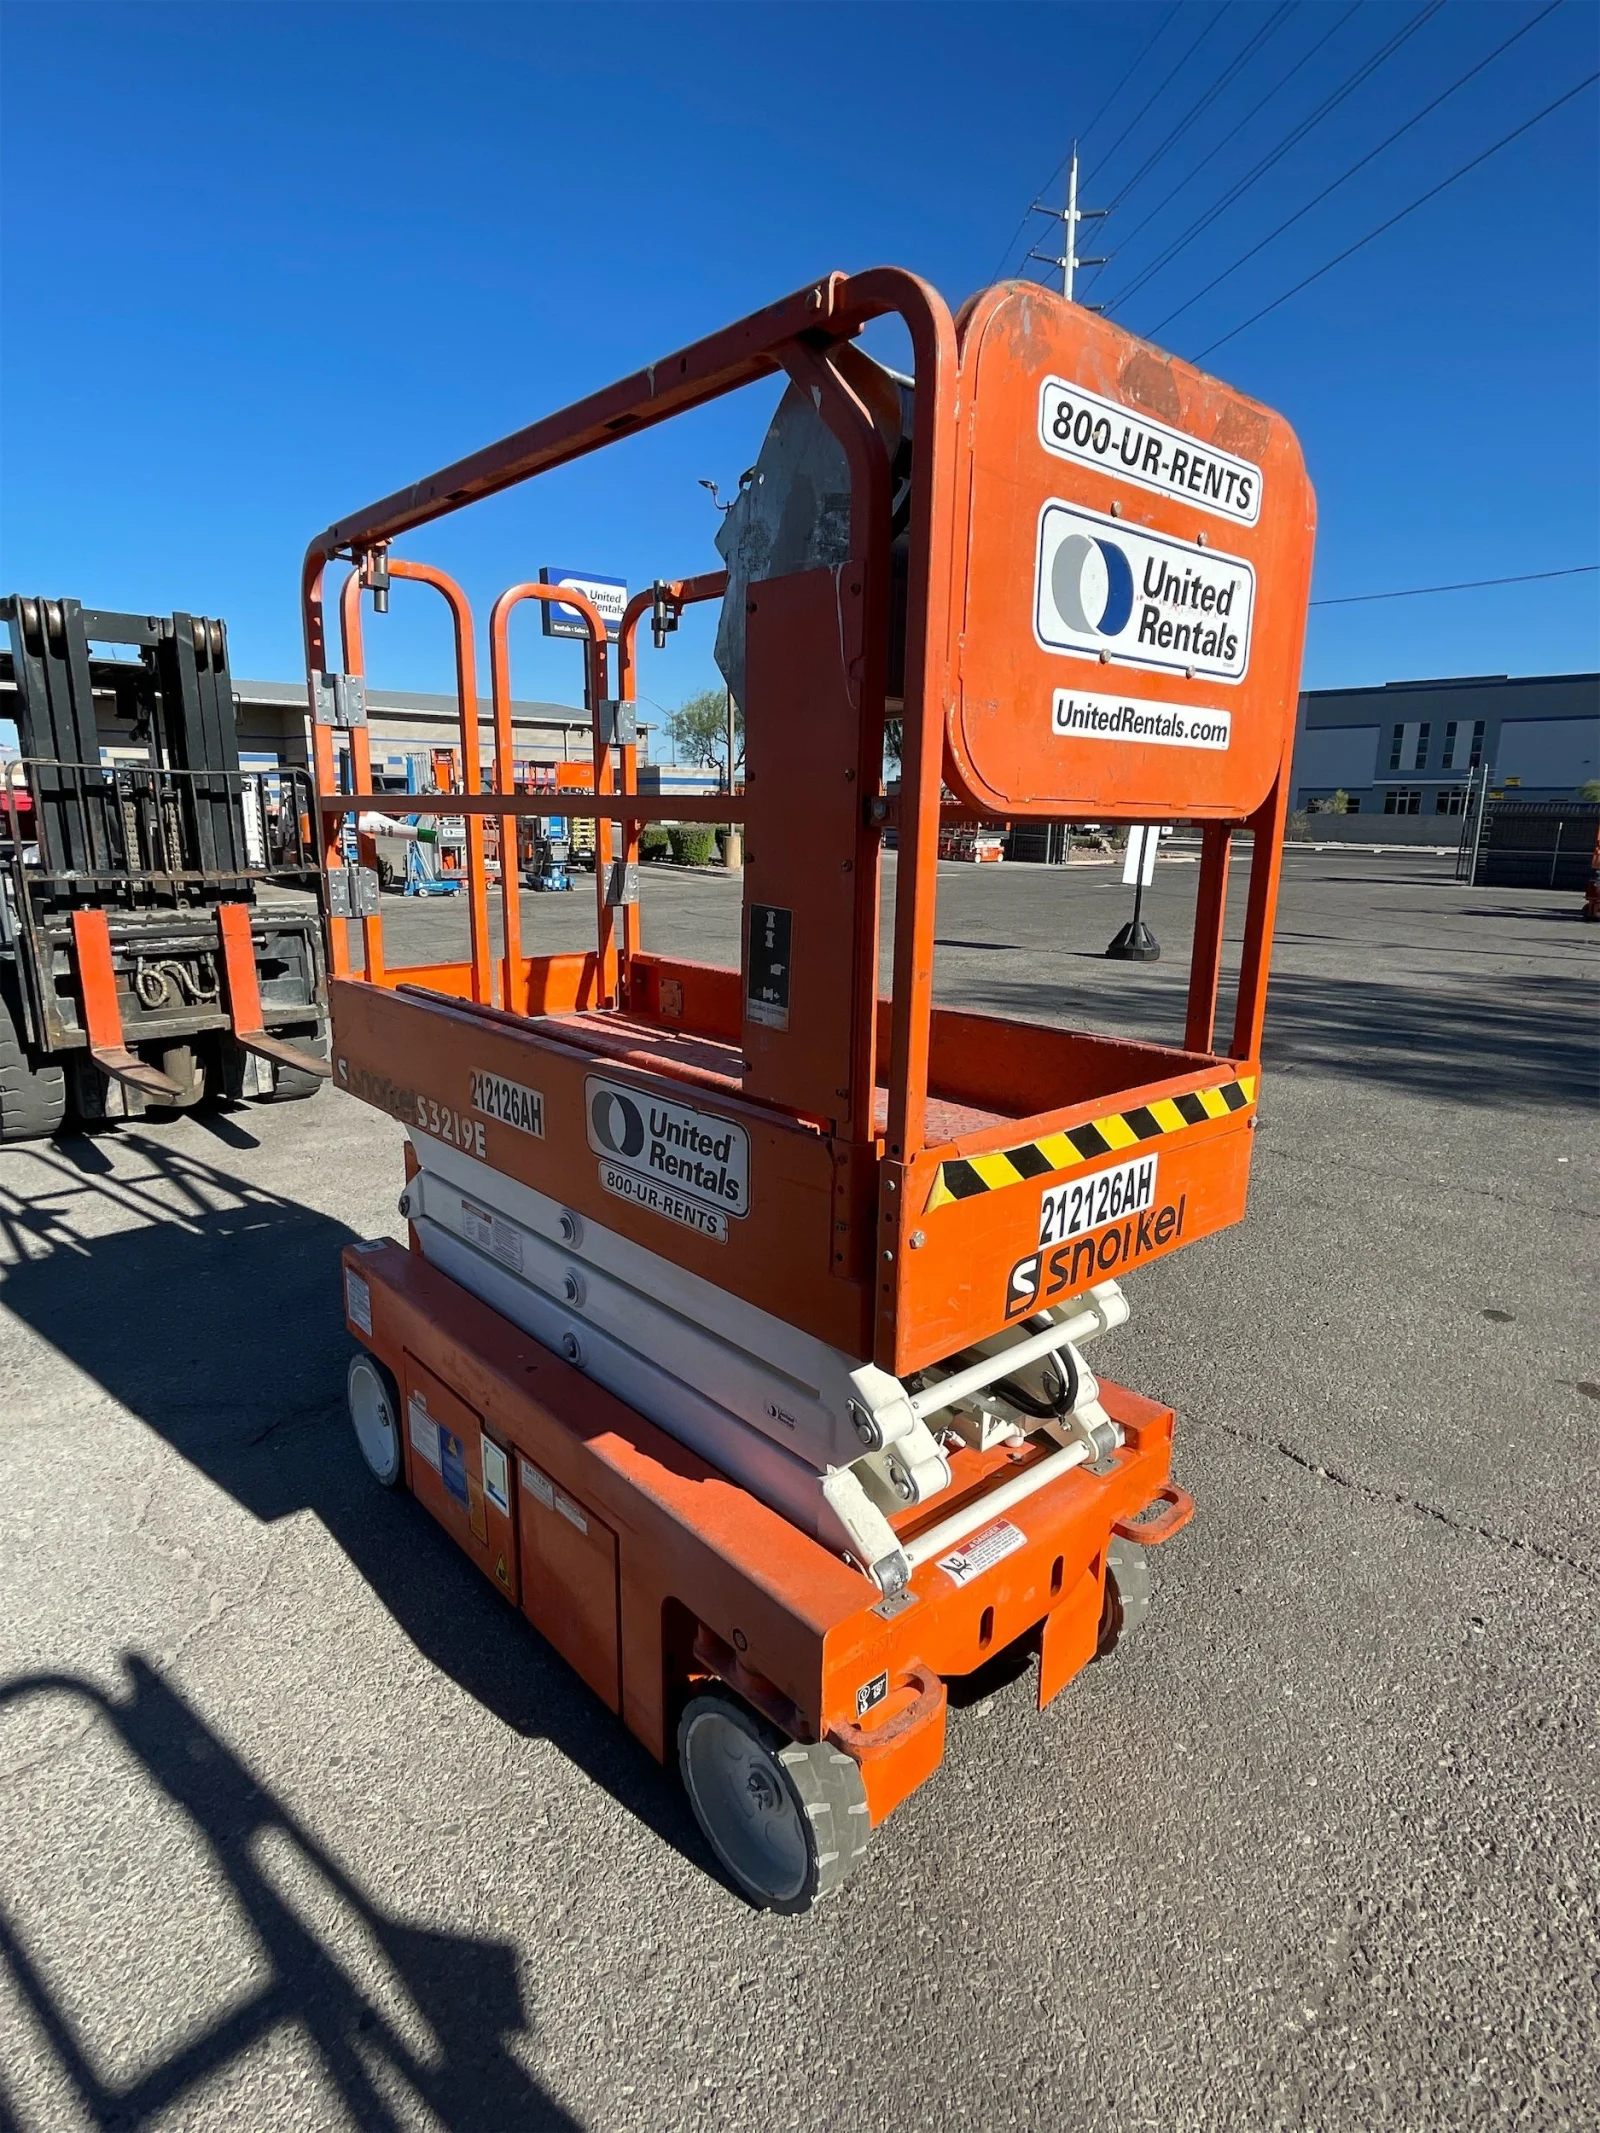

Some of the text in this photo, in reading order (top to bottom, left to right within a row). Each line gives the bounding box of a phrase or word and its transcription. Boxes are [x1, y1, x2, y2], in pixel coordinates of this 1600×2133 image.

[1052, 401, 1253, 509] 800-UR-RENTS
[589, 589, 621, 603] United
[1143, 556, 1236, 616] United
[1138, 606, 1238, 661] Rentals
[1057, 698, 1228, 743] UnitedRentals.com
[417, 1095, 487, 1159] S3219E
[470, 1071, 542, 1137] 212126AH
[649, 1107, 732, 1164] United
[649, 1140, 741, 1202] Rentals
[606, 1171, 718, 1235] 800-UR-RENTS
[1039, 1160, 1153, 1246] 212126AH
